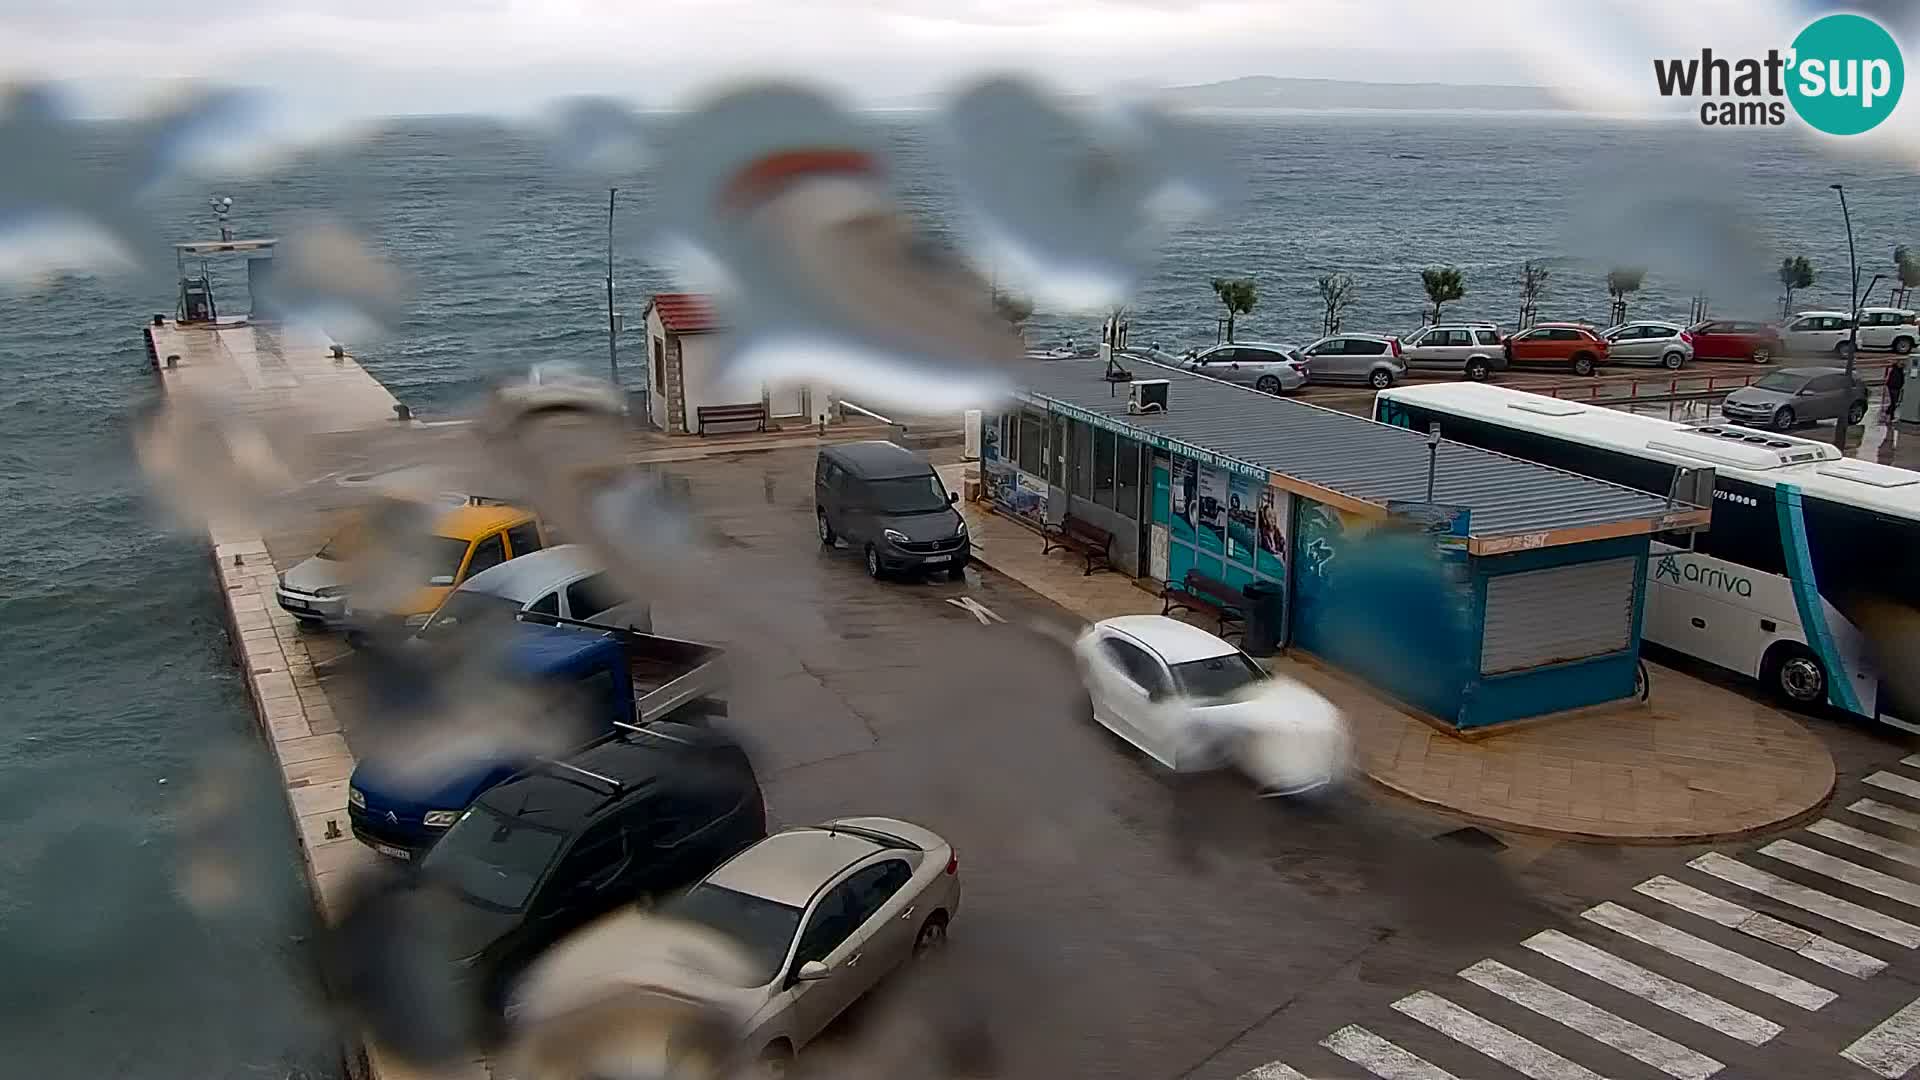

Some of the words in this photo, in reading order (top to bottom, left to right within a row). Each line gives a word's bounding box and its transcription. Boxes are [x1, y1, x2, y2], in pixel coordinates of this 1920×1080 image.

[1168, 441, 1182, 453] BUS
[1183, 446, 1213, 463] STATION
[1215, 456, 1240, 472] TICKET
[1240, 465, 1266, 481] OFFICE
[1683, 562, 1752, 598] arriva
